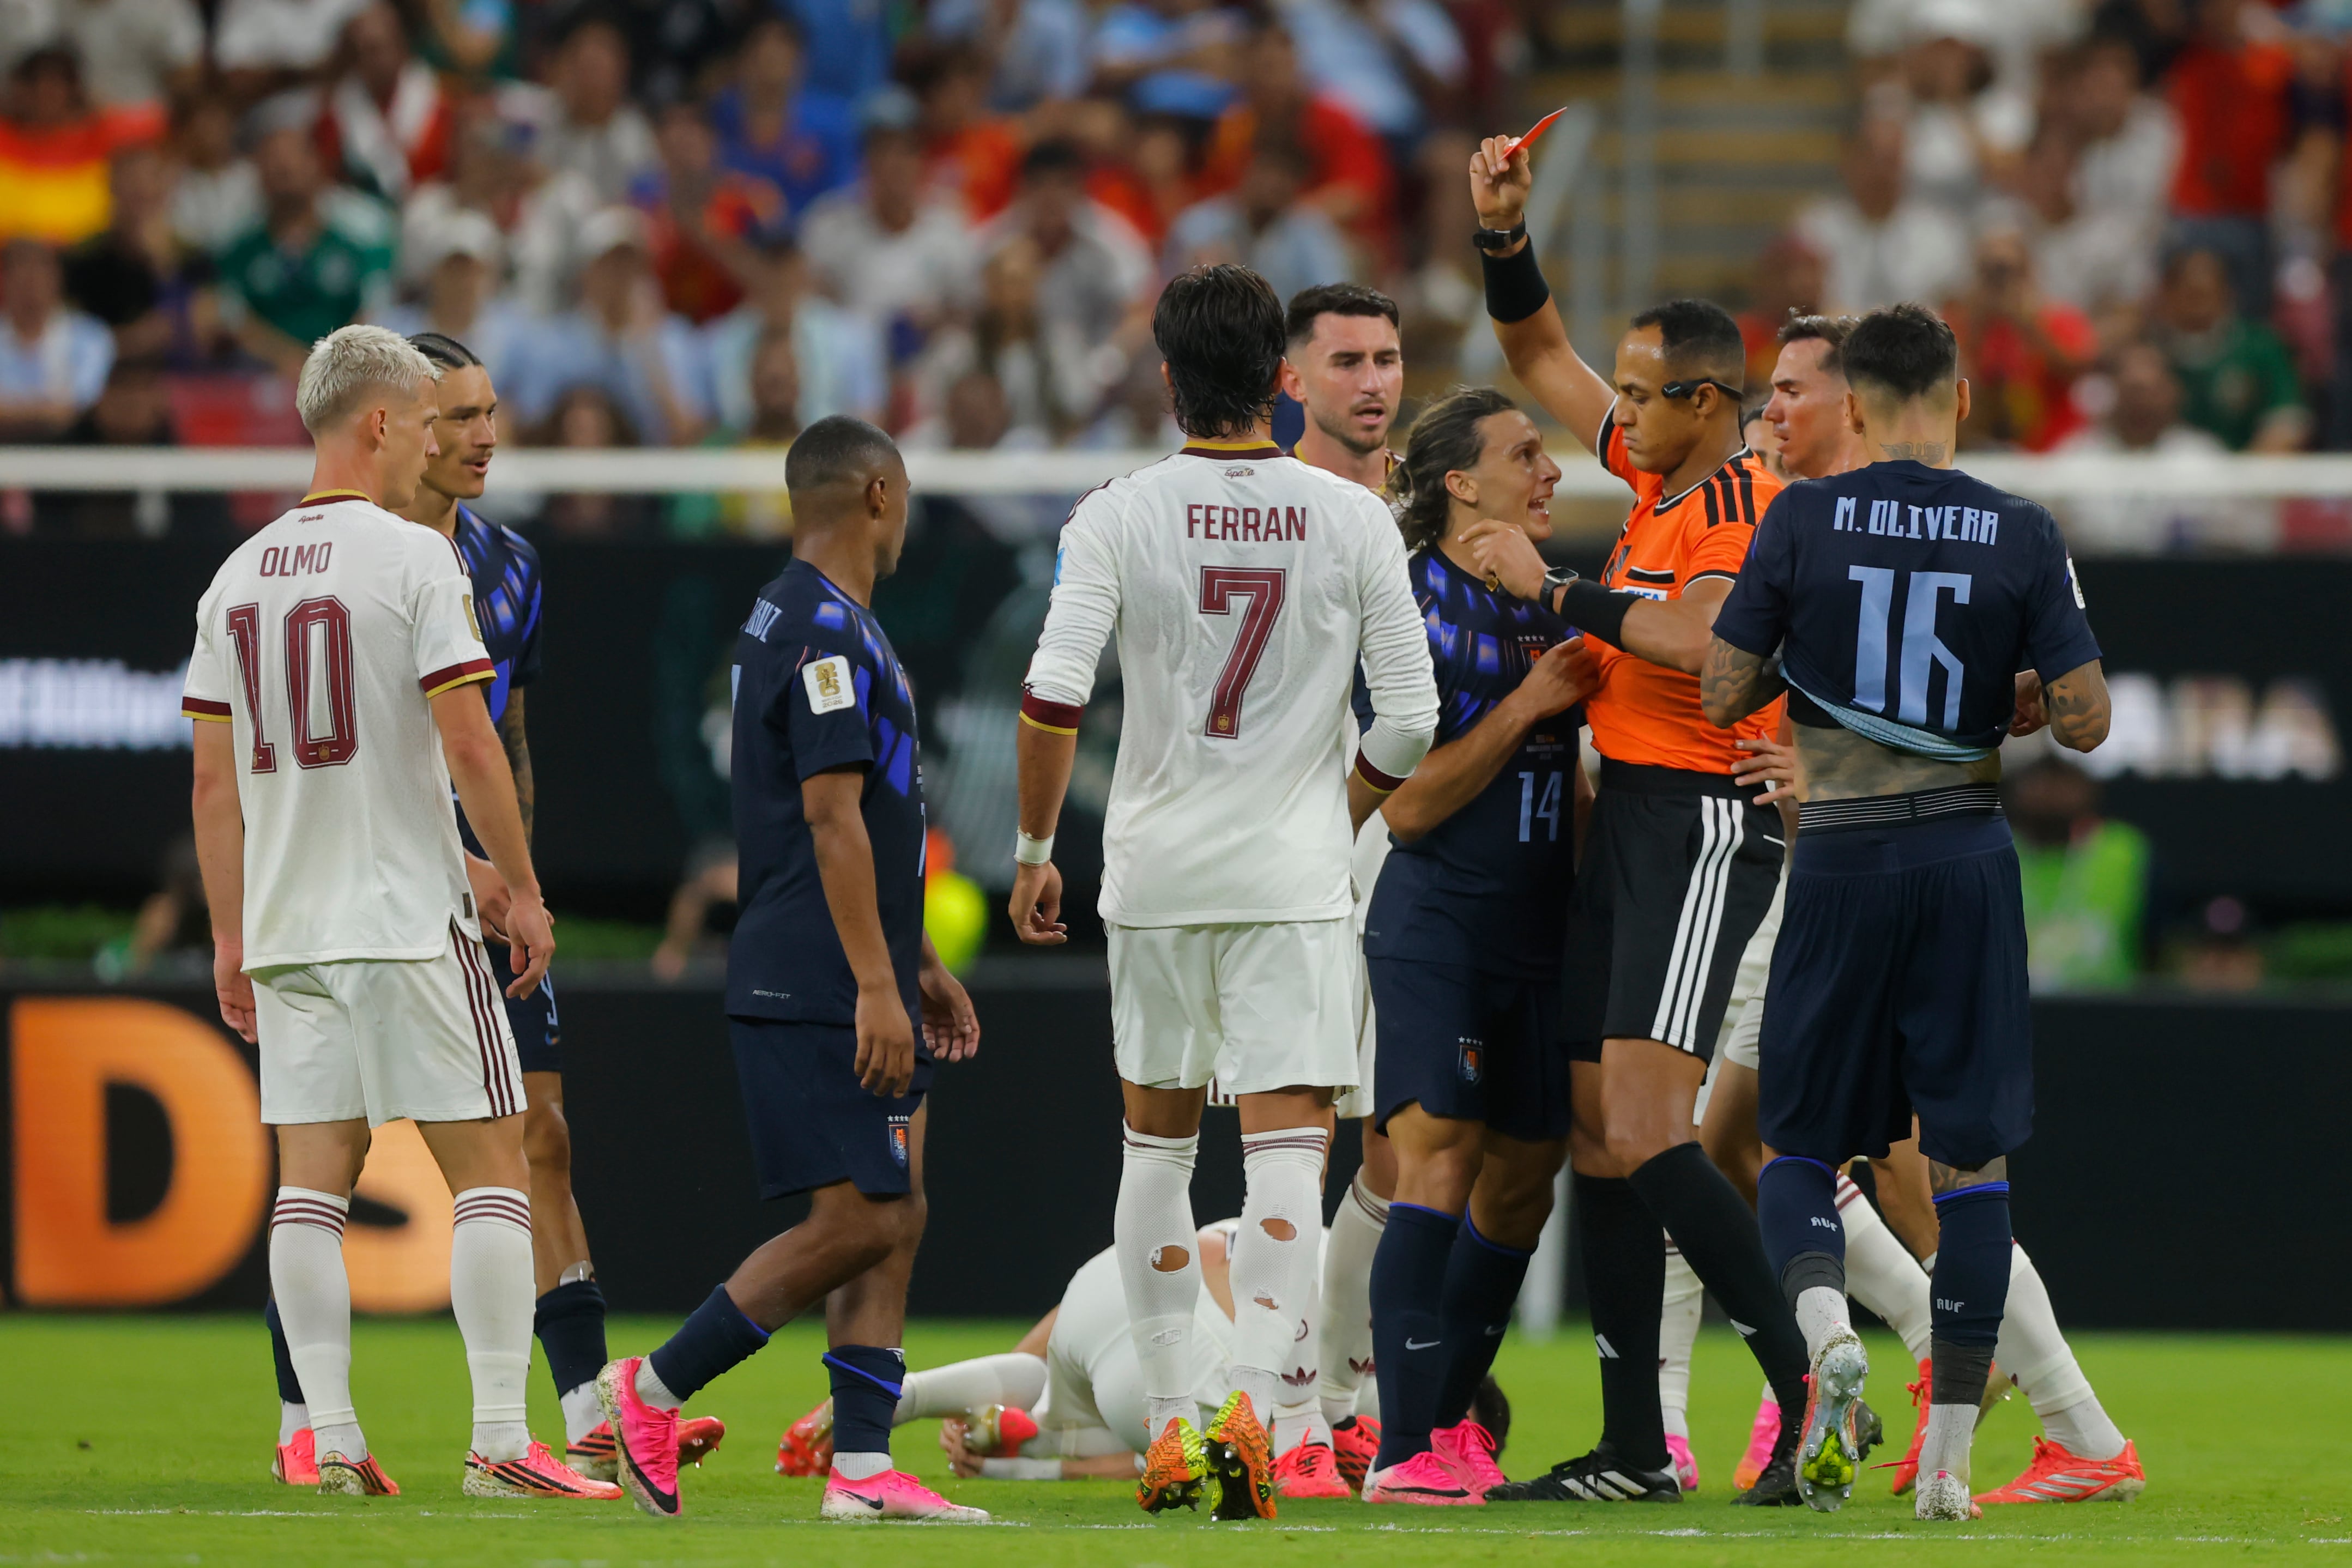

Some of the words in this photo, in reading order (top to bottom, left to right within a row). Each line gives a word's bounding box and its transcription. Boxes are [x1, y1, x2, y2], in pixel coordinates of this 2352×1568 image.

[1187, 504, 1307, 542] FERRAN
[1834, 497, 1863, 534] M.
[1869, 499, 1999, 546] OLIVERA
[259, 541, 332, 577] OLMO
[1199, 565, 1286, 740] 7
[1848, 565, 1973, 732] 16
[227, 595, 359, 774] 10
[822, 699, 843, 708] 2026
[1518, 771, 1563, 842] 14
[752, 989, 791, 999] AERO-FIT
[1810, 1216, 1838, 1232] AUF
[1936, 1298, 1965, 1313] AUF
